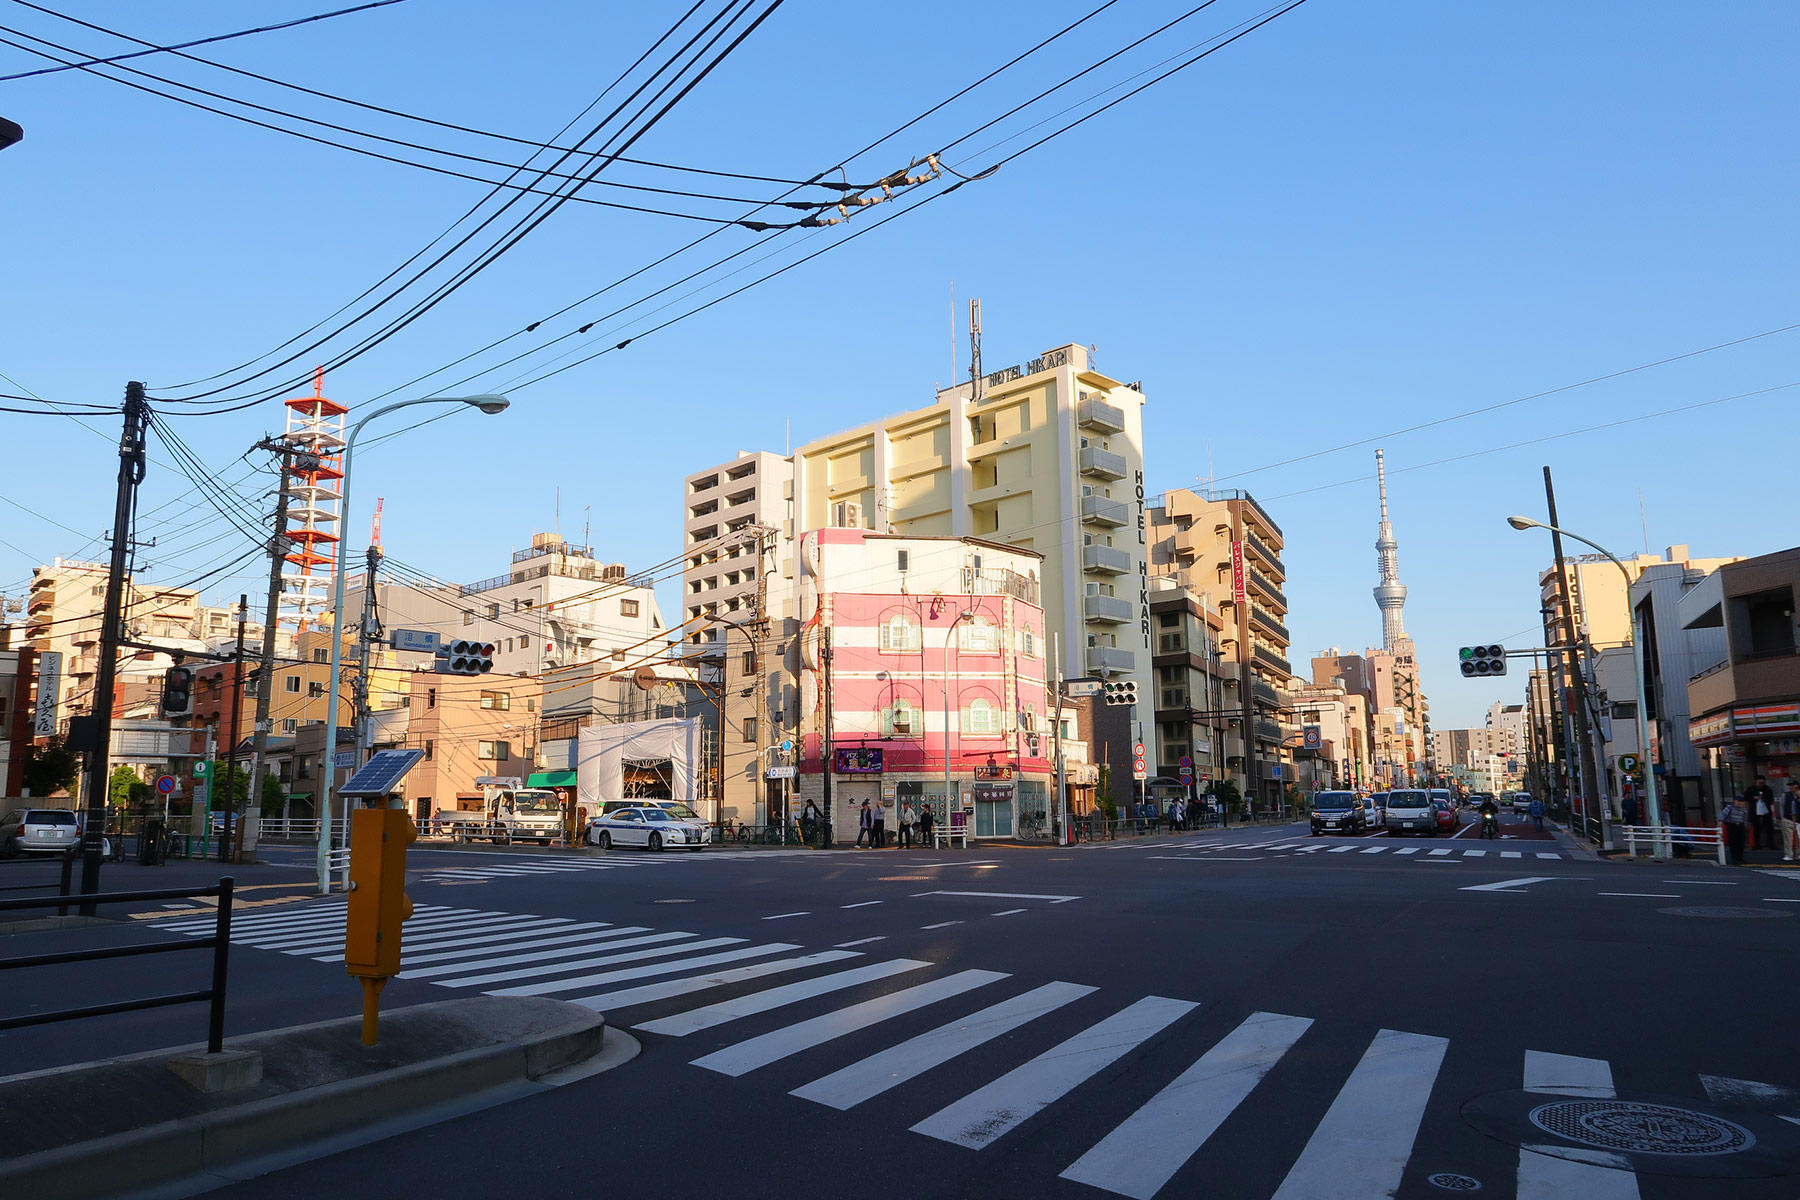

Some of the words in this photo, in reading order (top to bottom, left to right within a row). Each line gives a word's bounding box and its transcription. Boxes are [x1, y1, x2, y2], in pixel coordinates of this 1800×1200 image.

[988, 364, 1024, 387] HOTEL
[1026, 349, 1068, 376] HIKARI
[1135, 470, 1145, 545] HOTEL
[1138, 560, 1150, 649] HIKARI
[1625, 757, 1635, 769] P
